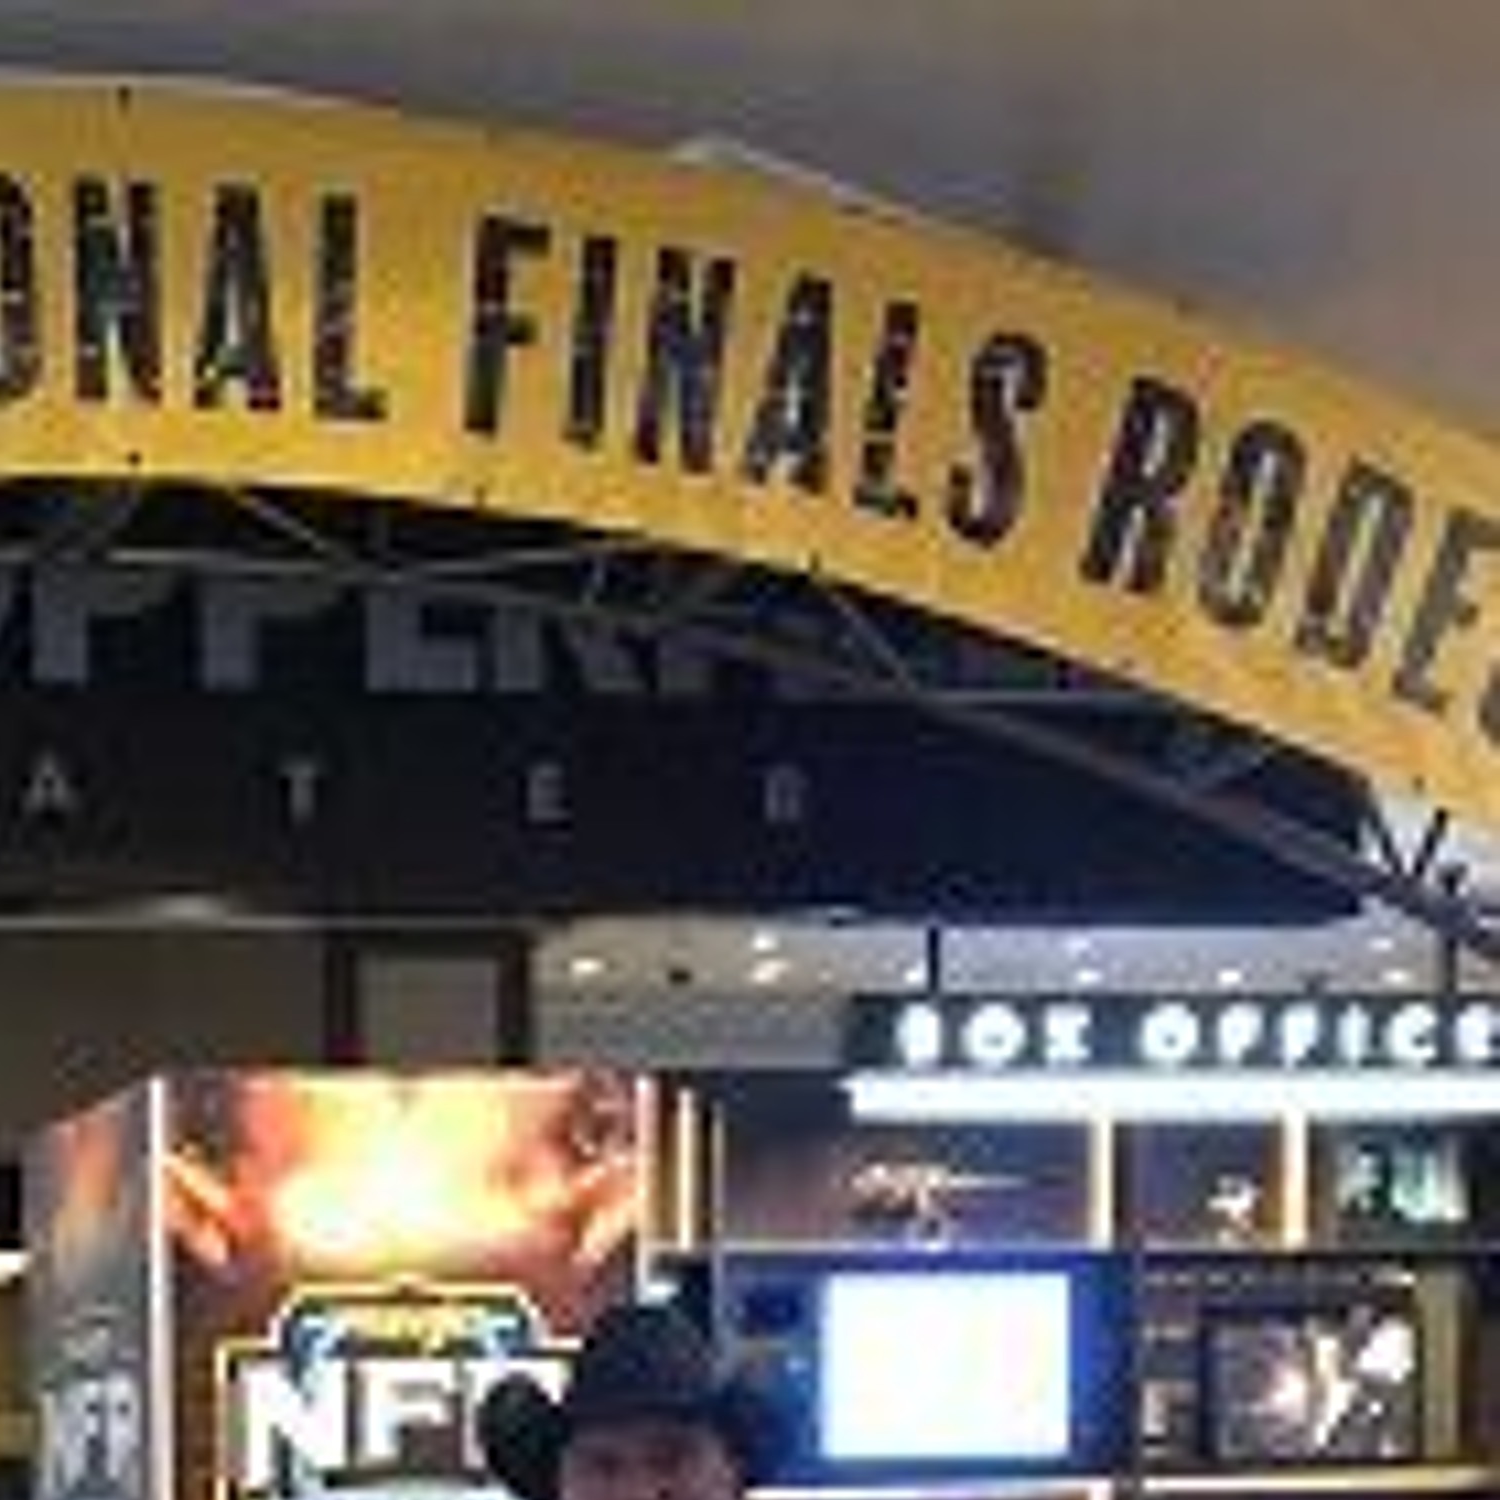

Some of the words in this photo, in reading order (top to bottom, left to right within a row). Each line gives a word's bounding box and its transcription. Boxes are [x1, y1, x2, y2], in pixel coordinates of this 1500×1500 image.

[463, 214, 1048, 549] FINALS
[1080, 375, 1500, 752] RODE
[899, 1003, 1093, 1064] BOX
[1140, 1003, 1500, 1064] OFFICE
